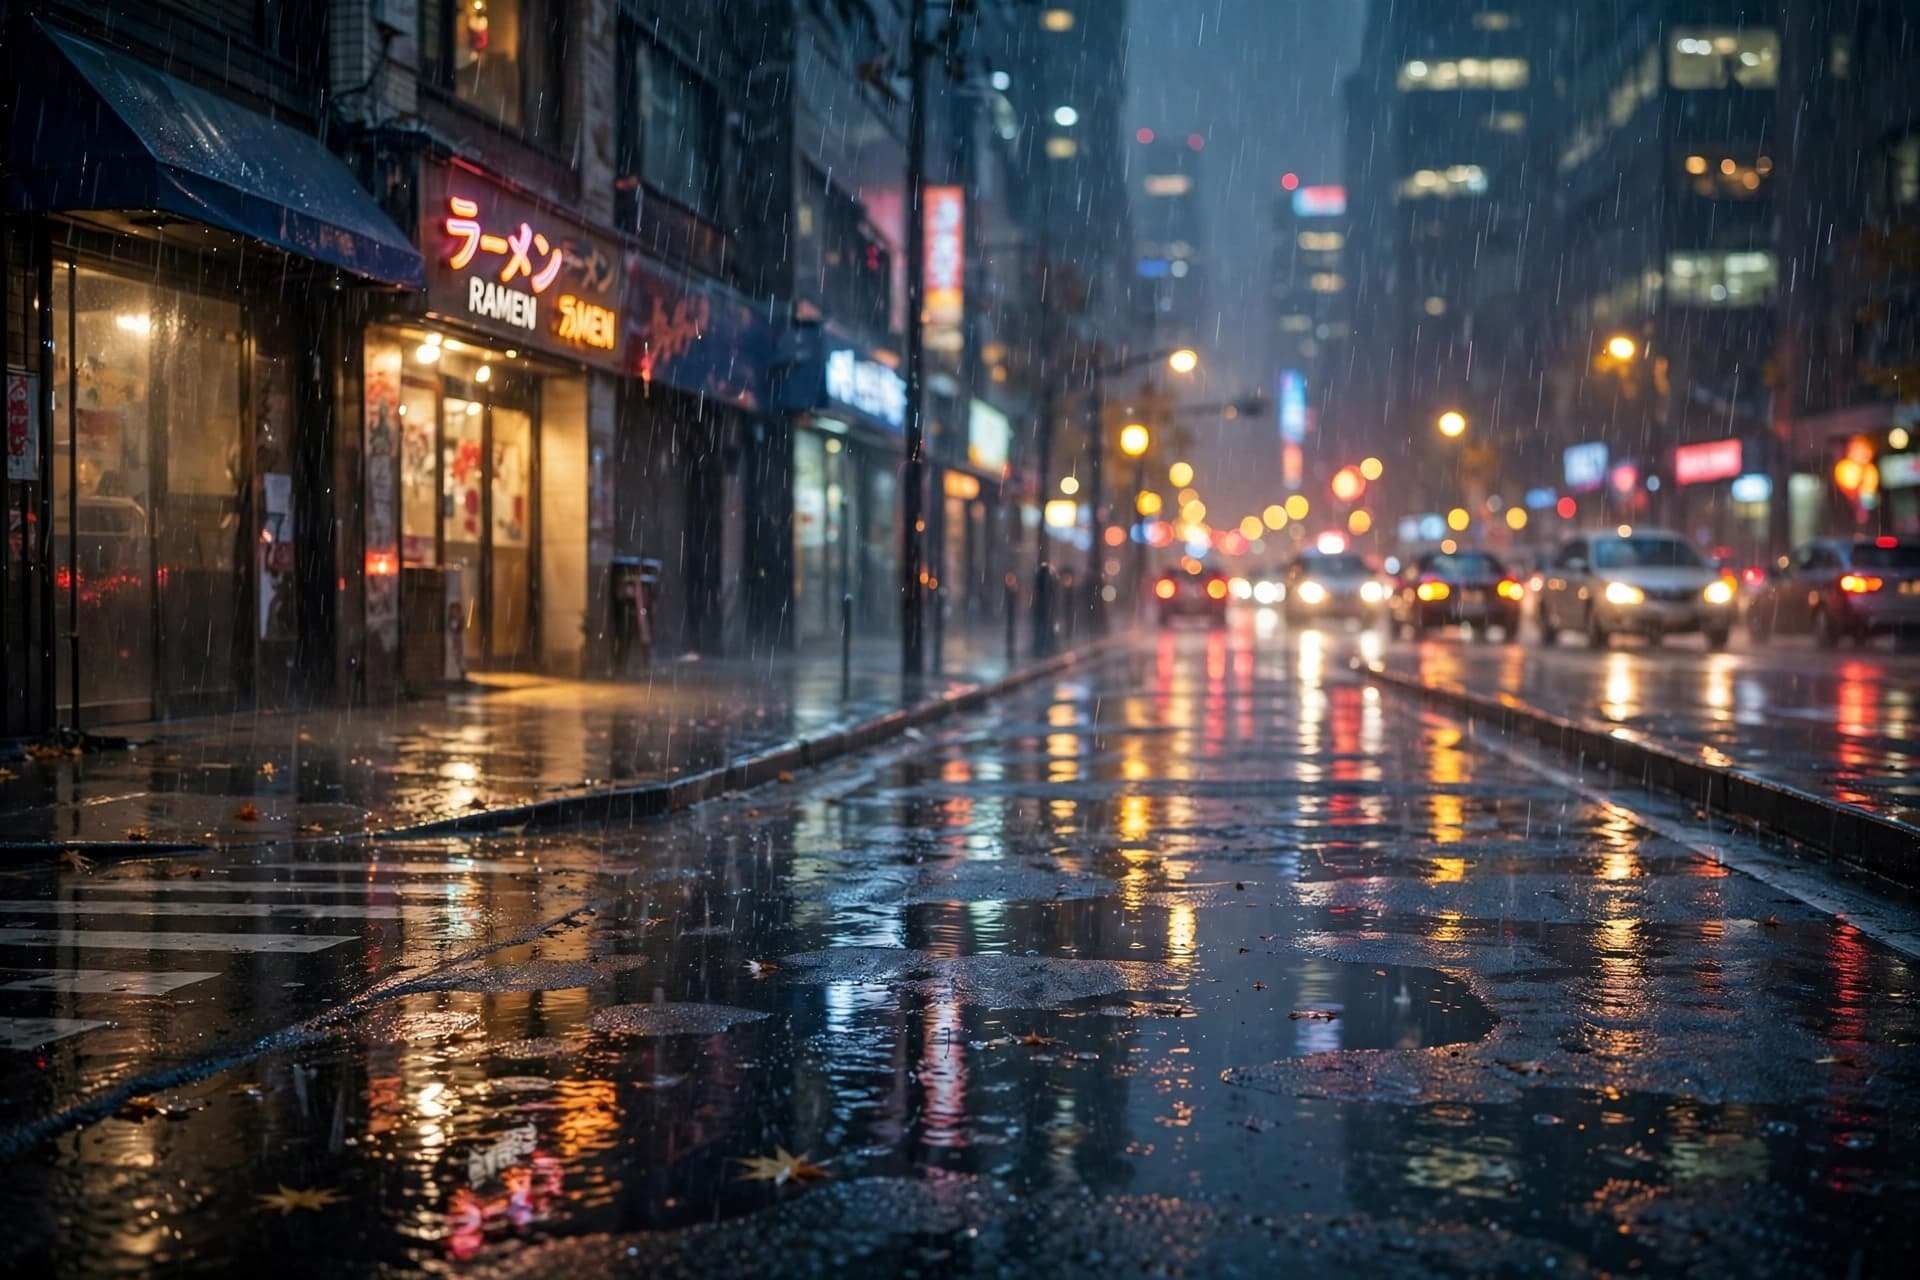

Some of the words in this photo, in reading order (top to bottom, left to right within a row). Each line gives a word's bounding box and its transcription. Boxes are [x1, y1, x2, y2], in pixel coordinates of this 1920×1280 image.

[446, 196, 563, 293] ラーメン
[469, 276, 537, 330] RAMEN
